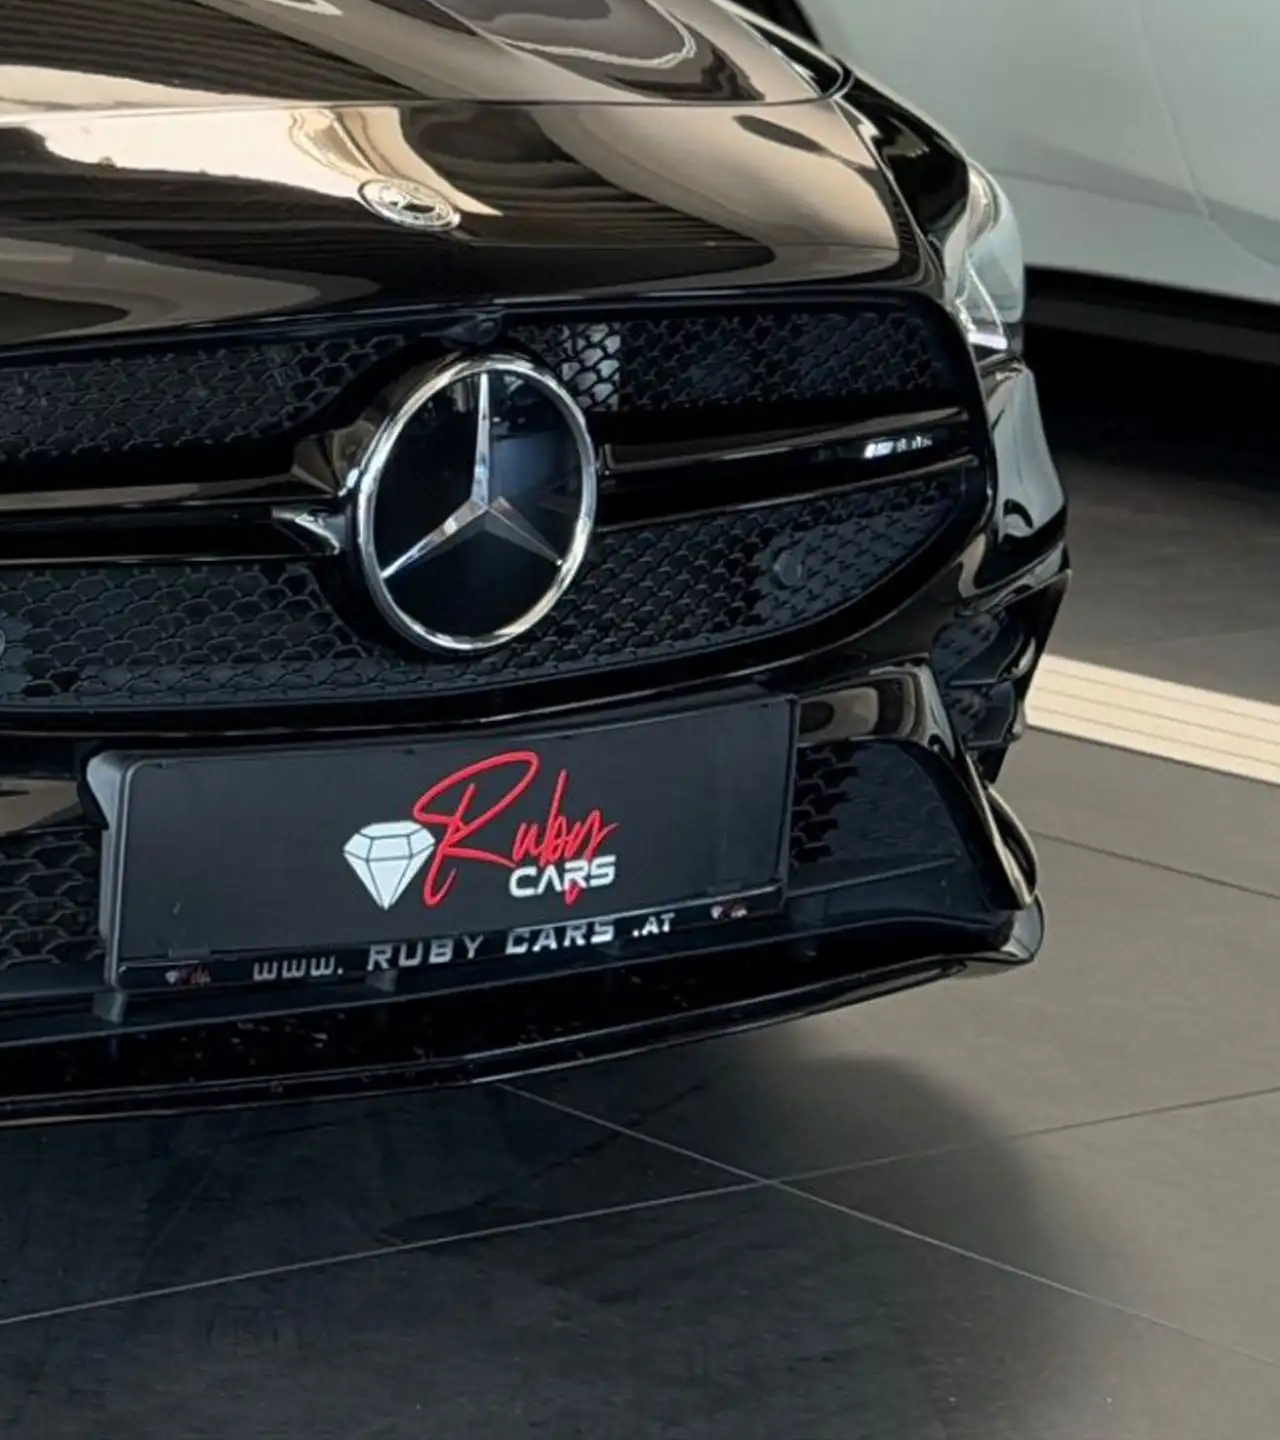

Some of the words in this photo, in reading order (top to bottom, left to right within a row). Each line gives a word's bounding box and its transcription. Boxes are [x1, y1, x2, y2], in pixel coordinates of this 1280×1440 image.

[413, 750, 620, 906] Ruby
[509, 854, 617, 898] CARS
[366, 934, 485, 972] RUBY
[504, 918, 616, 956] CARS
